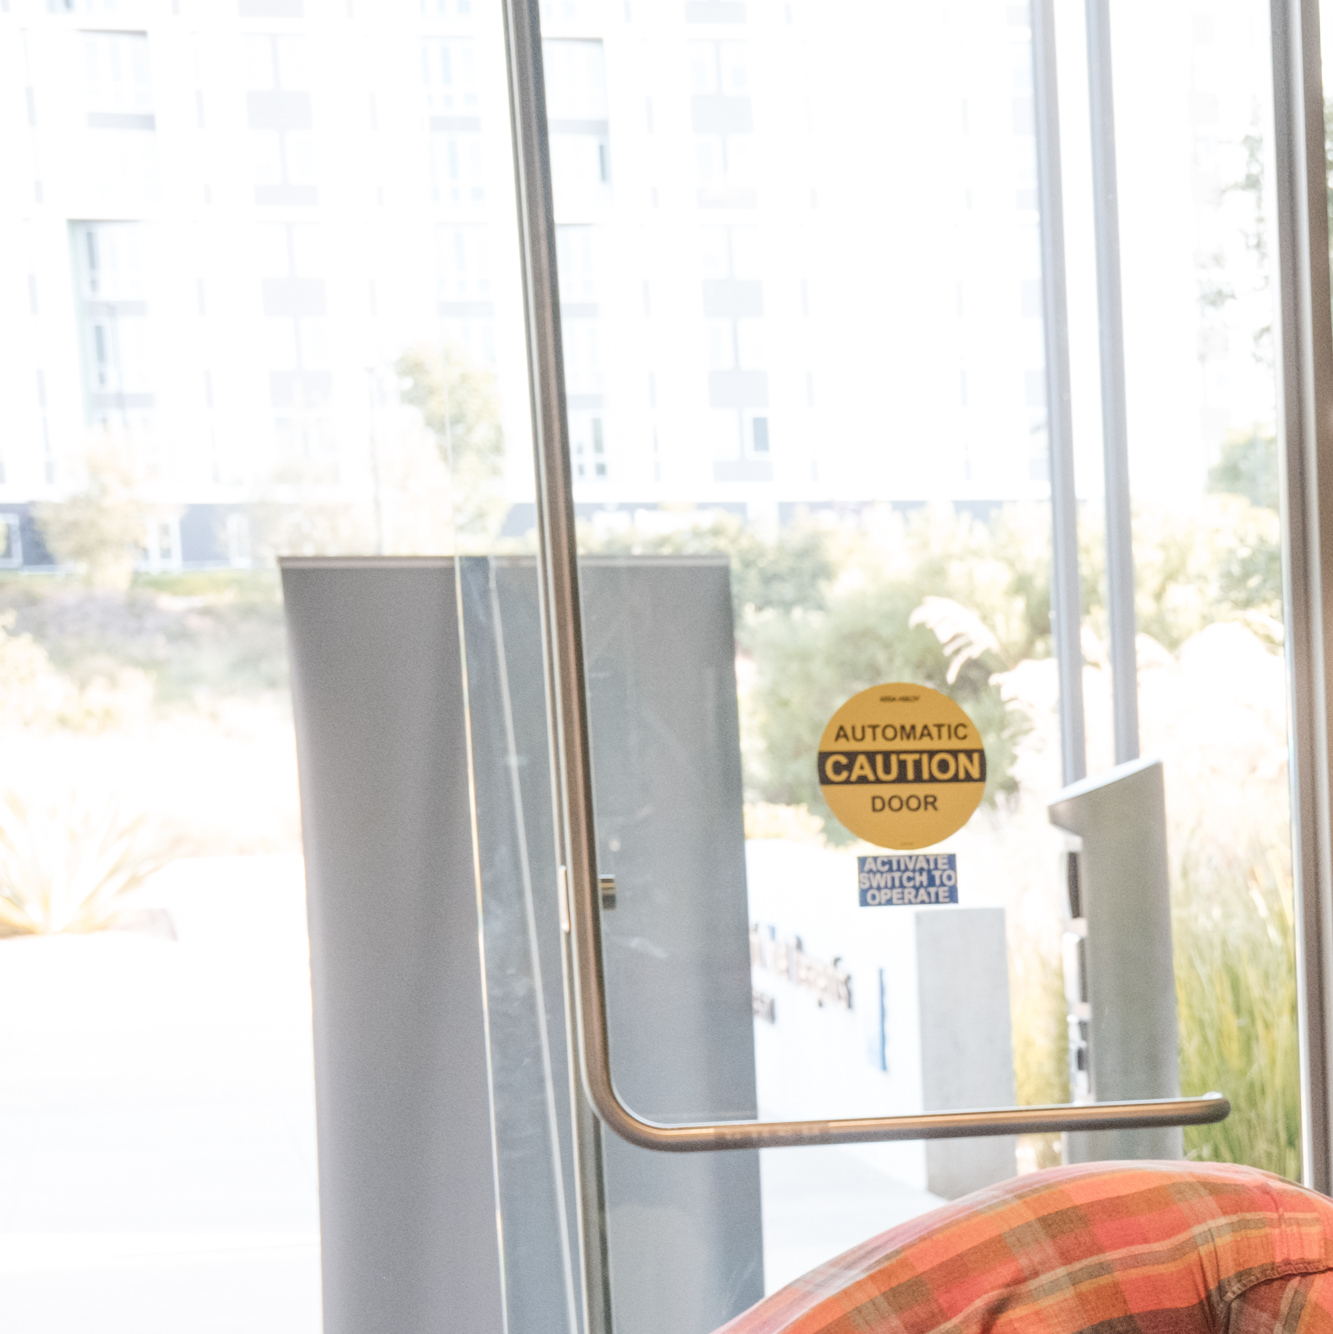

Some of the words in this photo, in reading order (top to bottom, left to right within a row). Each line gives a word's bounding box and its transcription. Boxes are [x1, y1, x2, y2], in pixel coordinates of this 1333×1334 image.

[834, 723, 968, 742] AUTOMATIC
[825, 752, 980, 783] CAUTION
[871, 794, 938, 812] DOOR
[863, 855, 949, 872] ACTIVATE
[859, 871, 928, 890] SWITCH
[931, 870, 957, 887] TO
[866, 886, 950, 905] OPERATE
